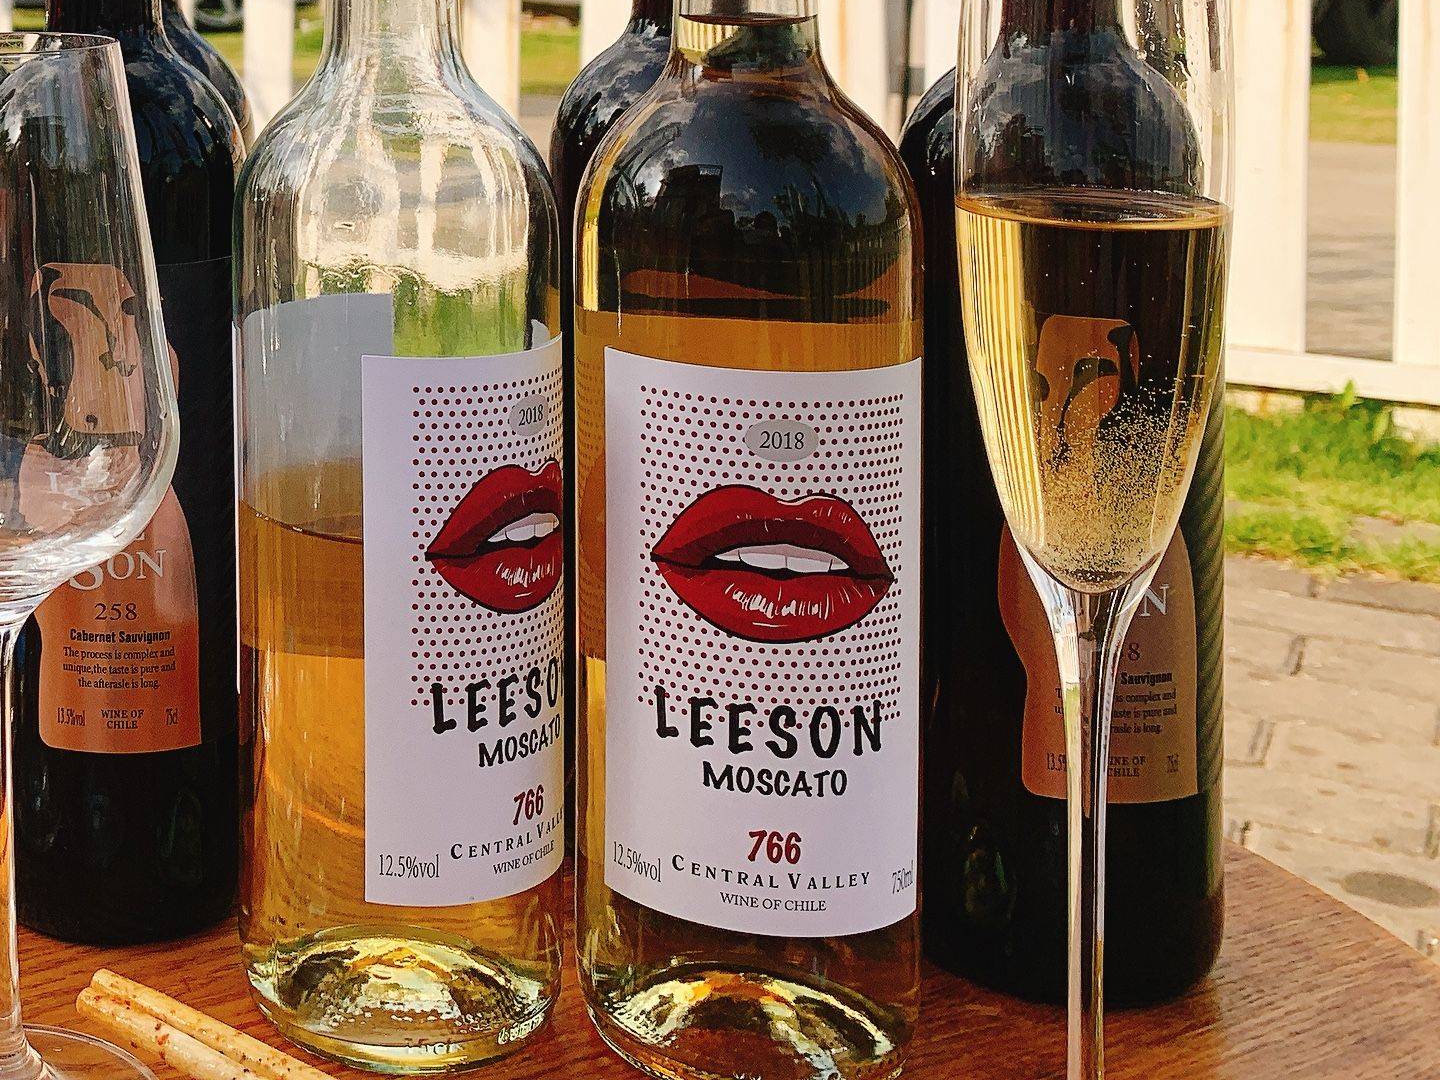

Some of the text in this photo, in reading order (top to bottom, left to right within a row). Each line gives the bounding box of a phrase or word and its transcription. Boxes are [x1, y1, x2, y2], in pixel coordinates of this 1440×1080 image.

[518, 403, 544, 426] 2018
[760, 430, 805, 450] 2018
[95, 602, 139, 621] 258
[69, 628, 171, 645] Cabernet Sauvignon
[63, 646, 176, 661] The process is complex and
[109, 665, 130, 675] taste
[130, 664, 139, 674] is
[140, 664, 160, 676] pure
[160, 661, 177, 672] and
[78, 677, 92, 688] the
[131, 679, 139, 689] is
[101, 709, 128, 719] WINE
[130, 709, 145, 719] OF
[106, 721, 139, 730] CHILE
[655, 685, 882, 759] LEESON
[478, 713, 561, 767] MOSCATO
[702, 761, 848, 798] MOSCATO
[512, 784, 545, 826] 766
[450, 832, 533, 860] CENTRAL
[493, 839, 556, 875] WINE OF CHILE
[747, 829, 802, 865] 766
[379, 853, 440, 879] 12.5%vol
[613, 840, 662, 883] 12.5%vol
[671, 854, 779, 889] CENTRAL
[787, 871, 870, 890] VALLEY
[720, 891, 827, 912] WINE OF CHILE
